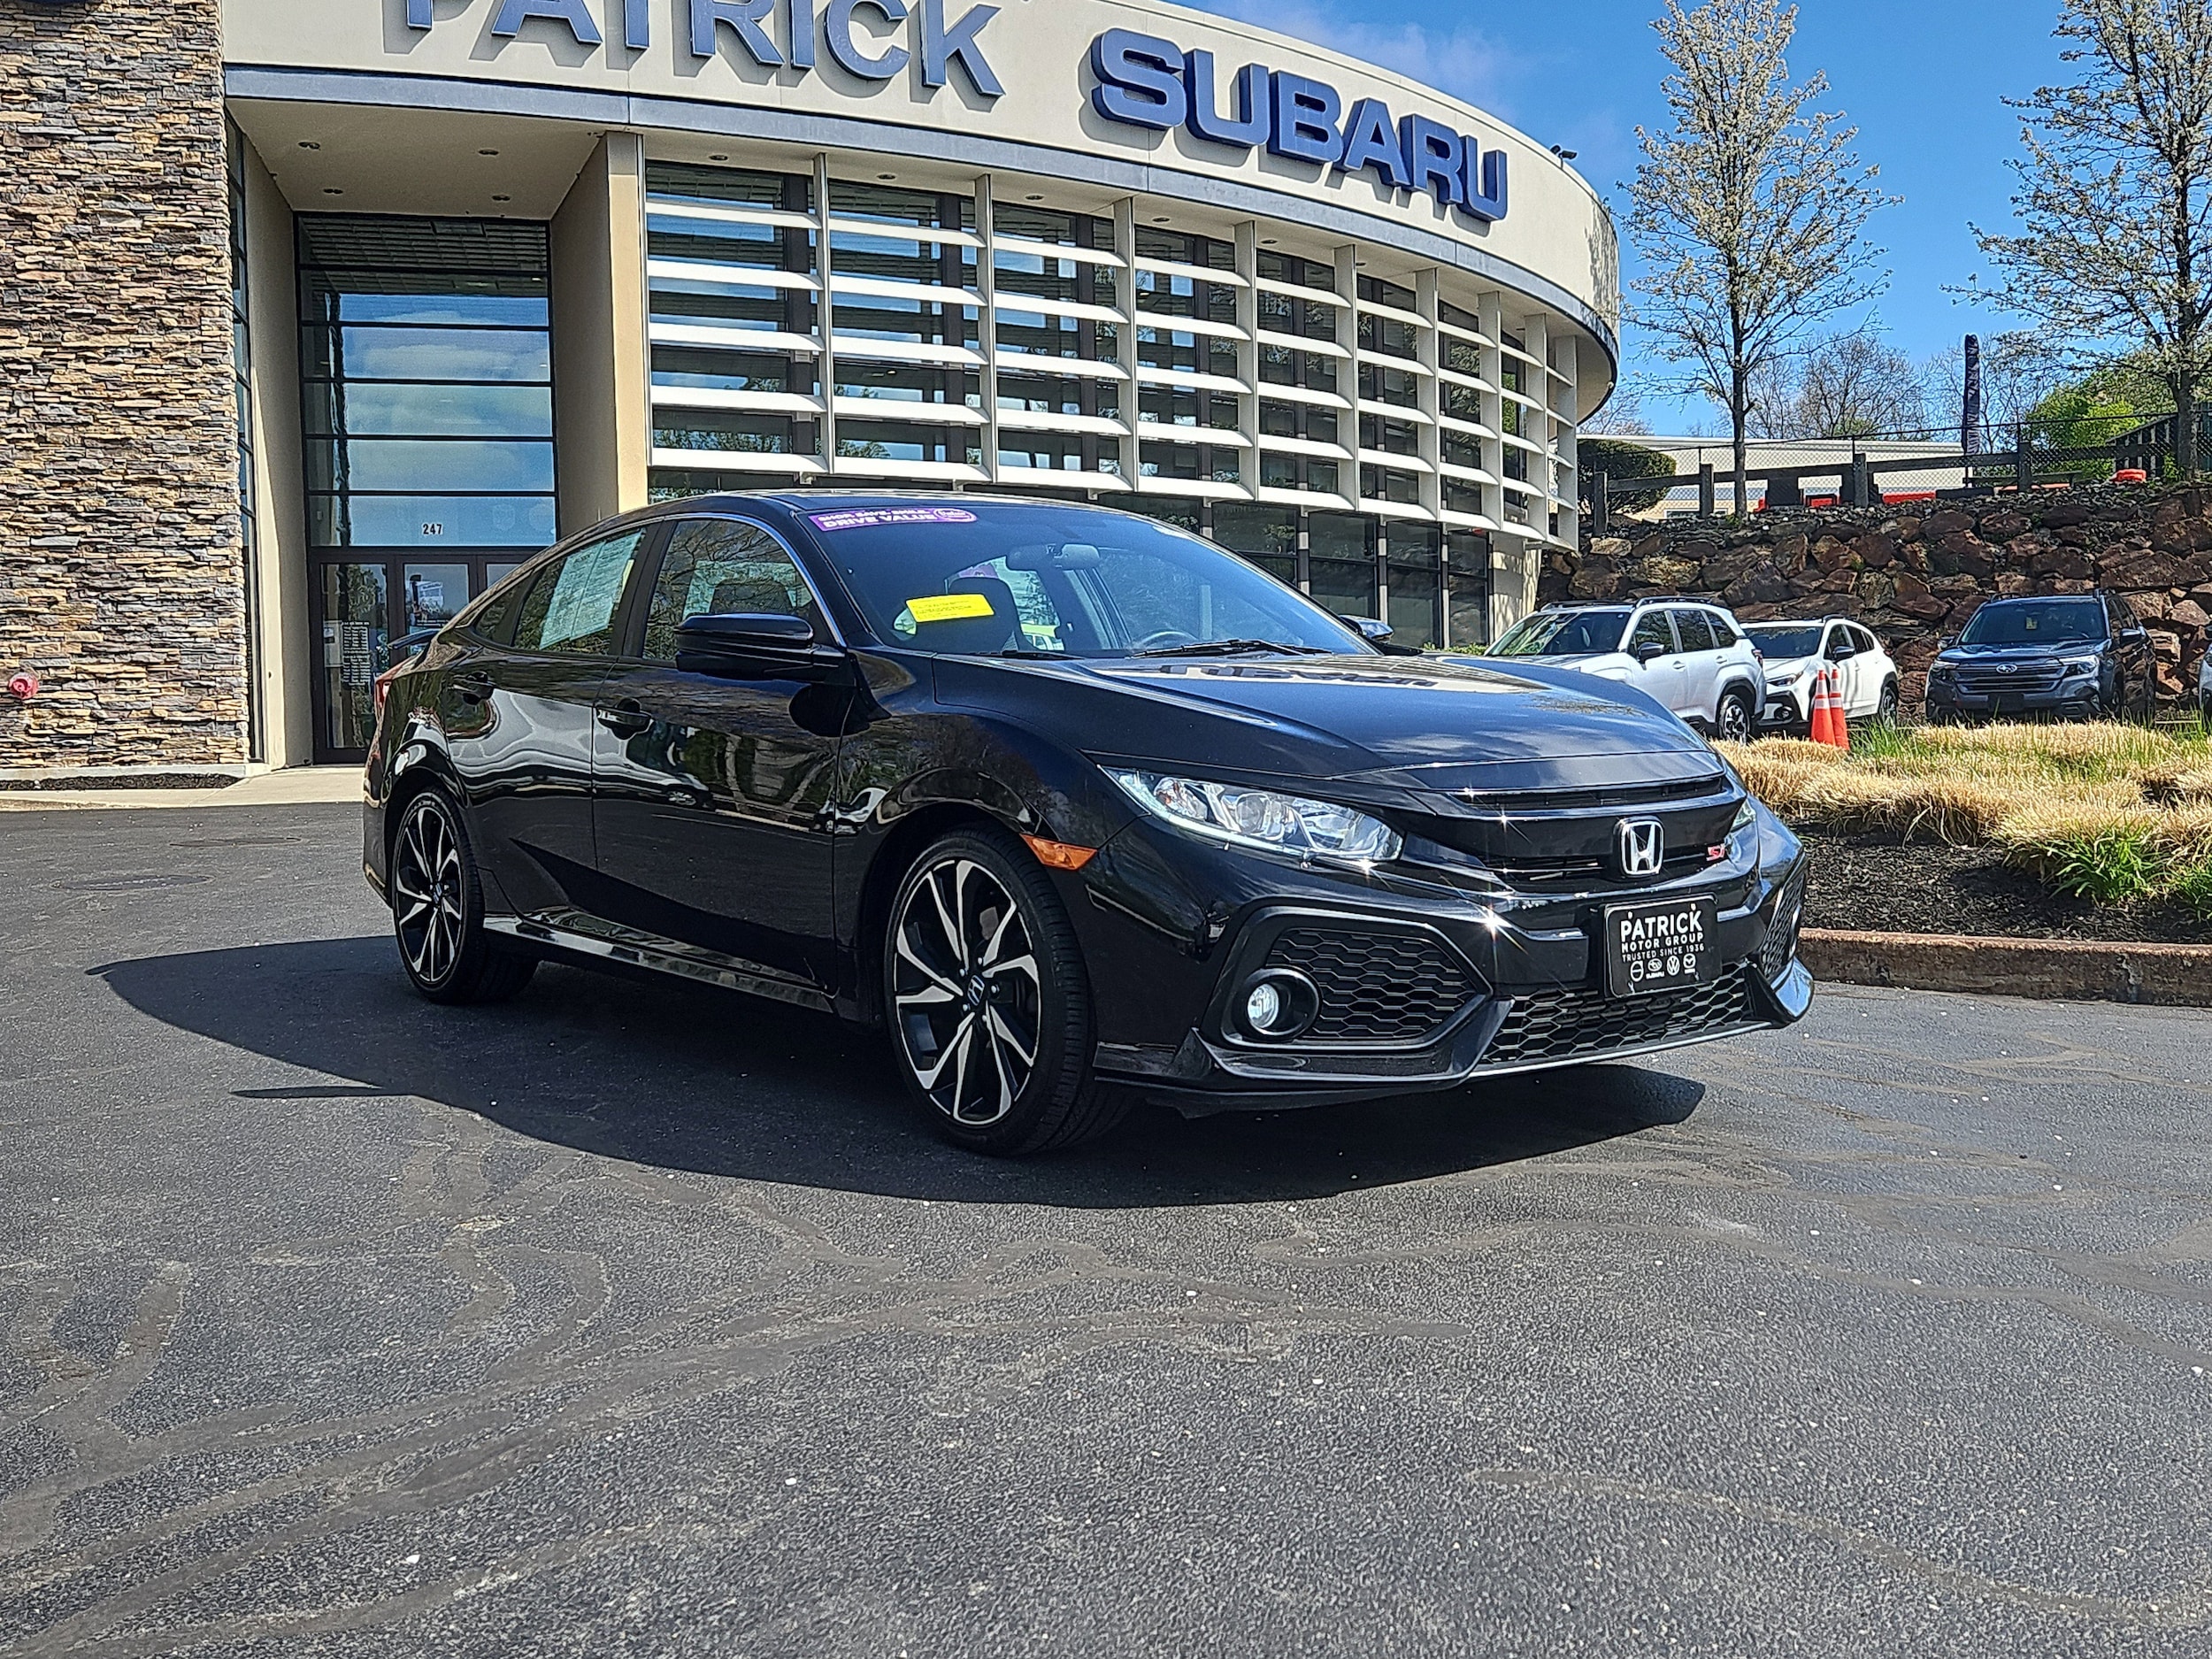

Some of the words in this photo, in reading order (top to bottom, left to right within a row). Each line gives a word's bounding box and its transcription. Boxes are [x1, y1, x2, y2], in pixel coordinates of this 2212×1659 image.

[1091, 27, 1509, 222] SUBARU
[422, 523, 442, 535] 247
[823, 516, 879, 528] DRIVE
[1621, 910, 1702, 942] PATRICK
[1622, 939, 1659, 953] MOTOR
[1665, 932, 1704, 947] GROUP
[1622, 950, 1657, 963] TRUSTED
[1659, 946, 1683, 957] SINCE
[1686, 942, 1705, 953] 1936
